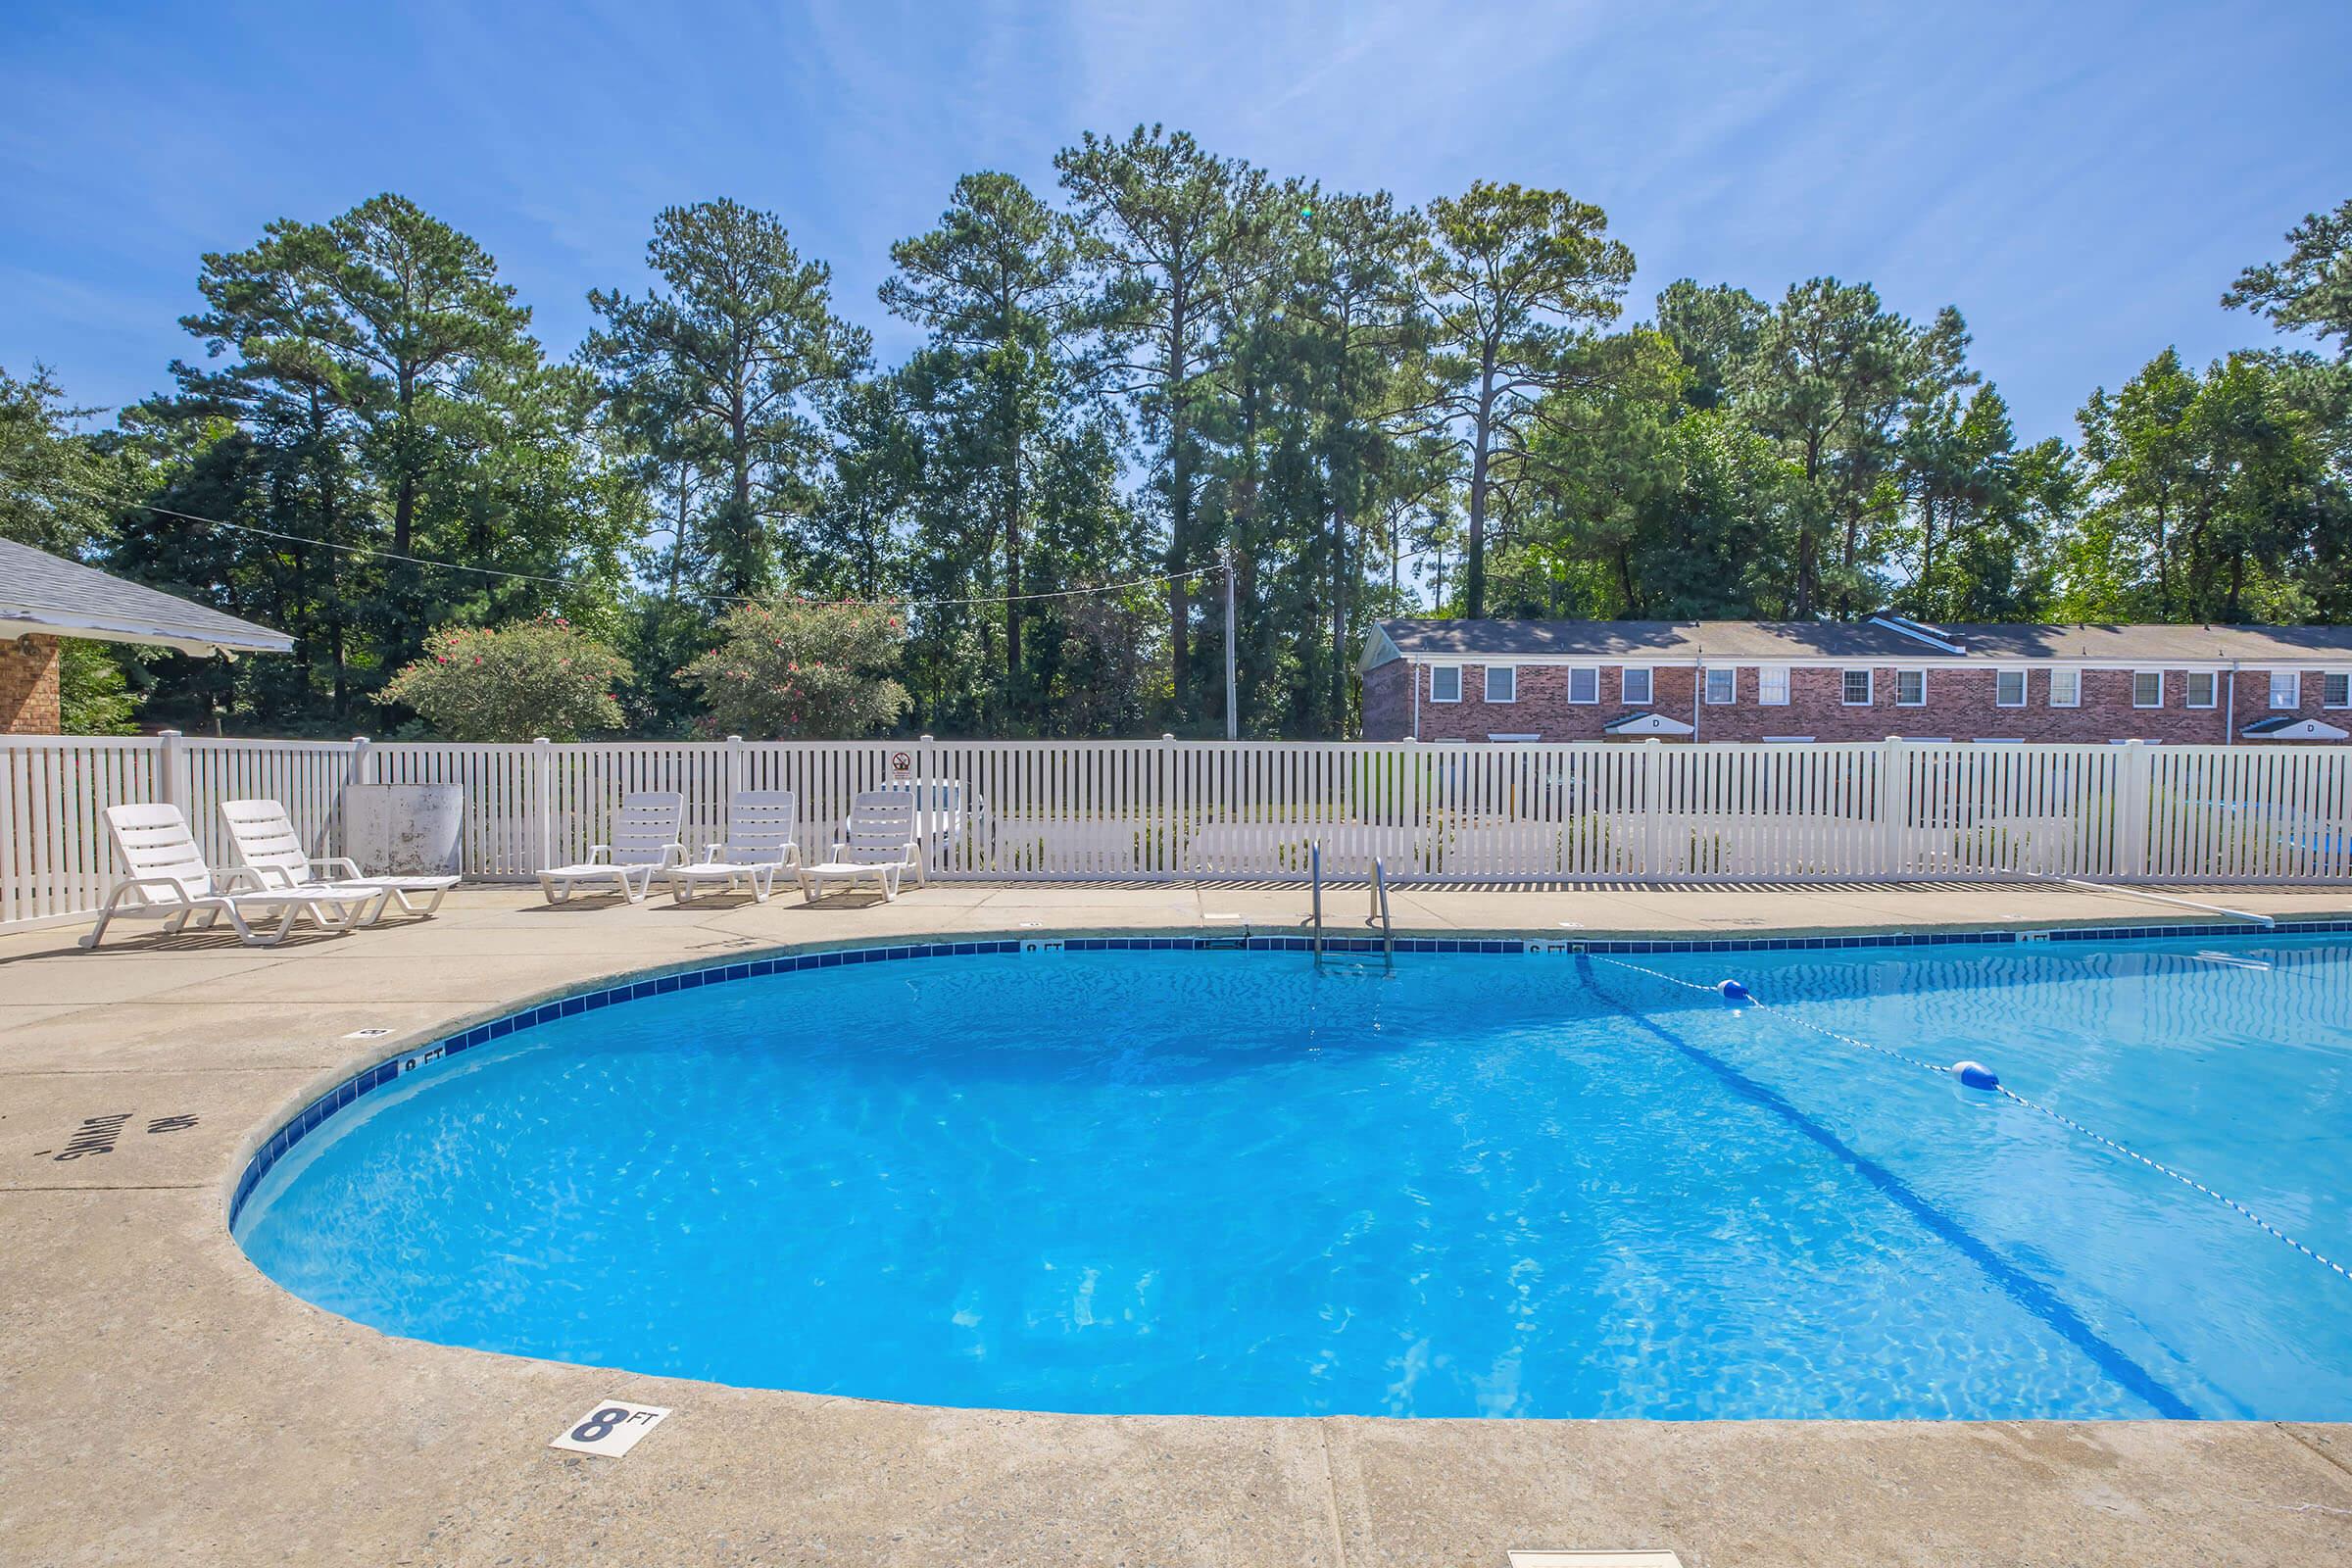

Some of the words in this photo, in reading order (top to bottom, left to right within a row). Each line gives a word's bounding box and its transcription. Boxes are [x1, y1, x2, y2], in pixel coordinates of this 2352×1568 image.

[1652, 719, 1660, 728] D
[53, 1113, 133, 1161] DIVING
[147, 1113, 199, 1134] NO
[570, 1407, 630, 1443] 8
[626, 1411, 660, 1425] FT
